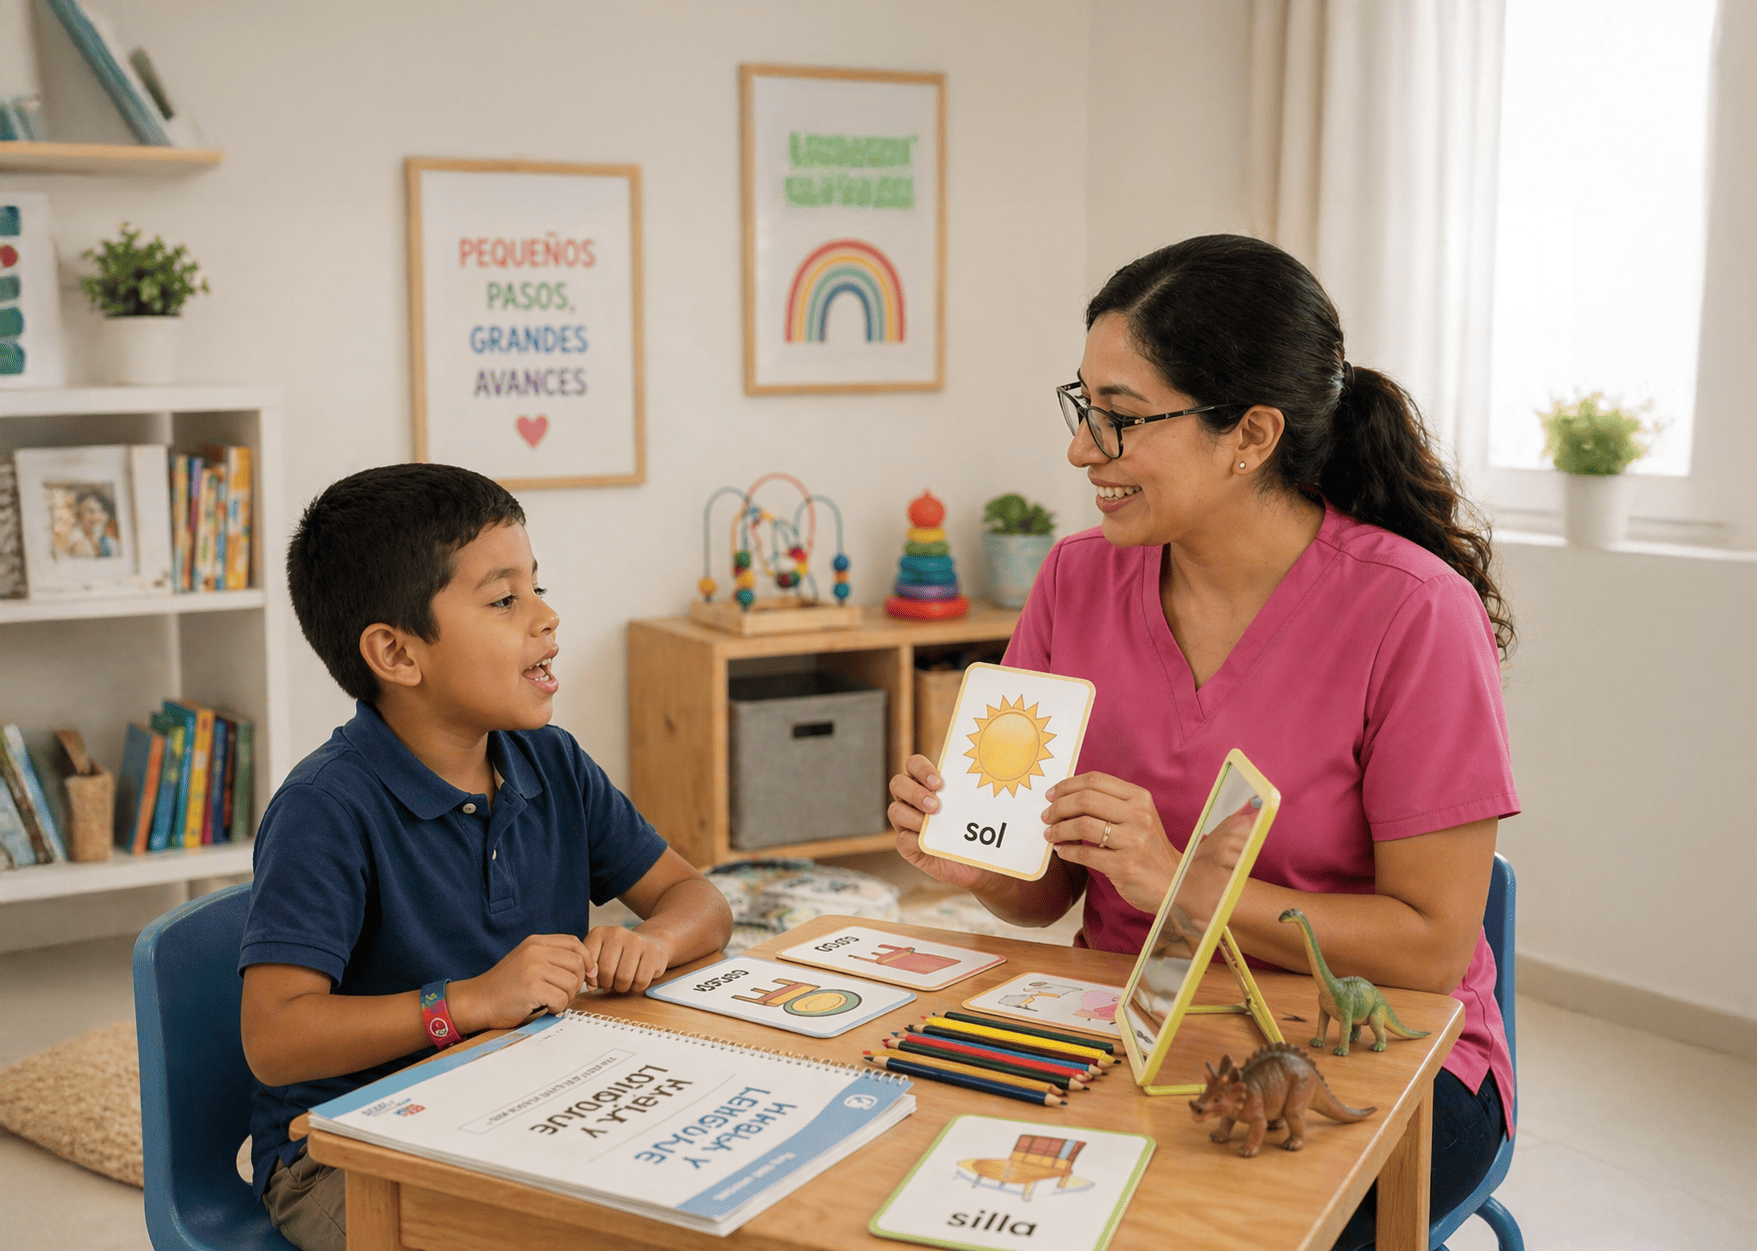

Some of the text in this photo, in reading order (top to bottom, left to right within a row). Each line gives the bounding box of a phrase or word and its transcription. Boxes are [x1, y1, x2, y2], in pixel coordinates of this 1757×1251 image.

[459, 231, 597, 269] PEQUEÑOS
[488, 281, 576, 313] PASOS,
[469, 325, 589, 355] GRANDES
[473, 368, 588, 397] AVANCES
[963, 821, 1008, 849] sol
[946, 1209, 1037, 1237] silla
